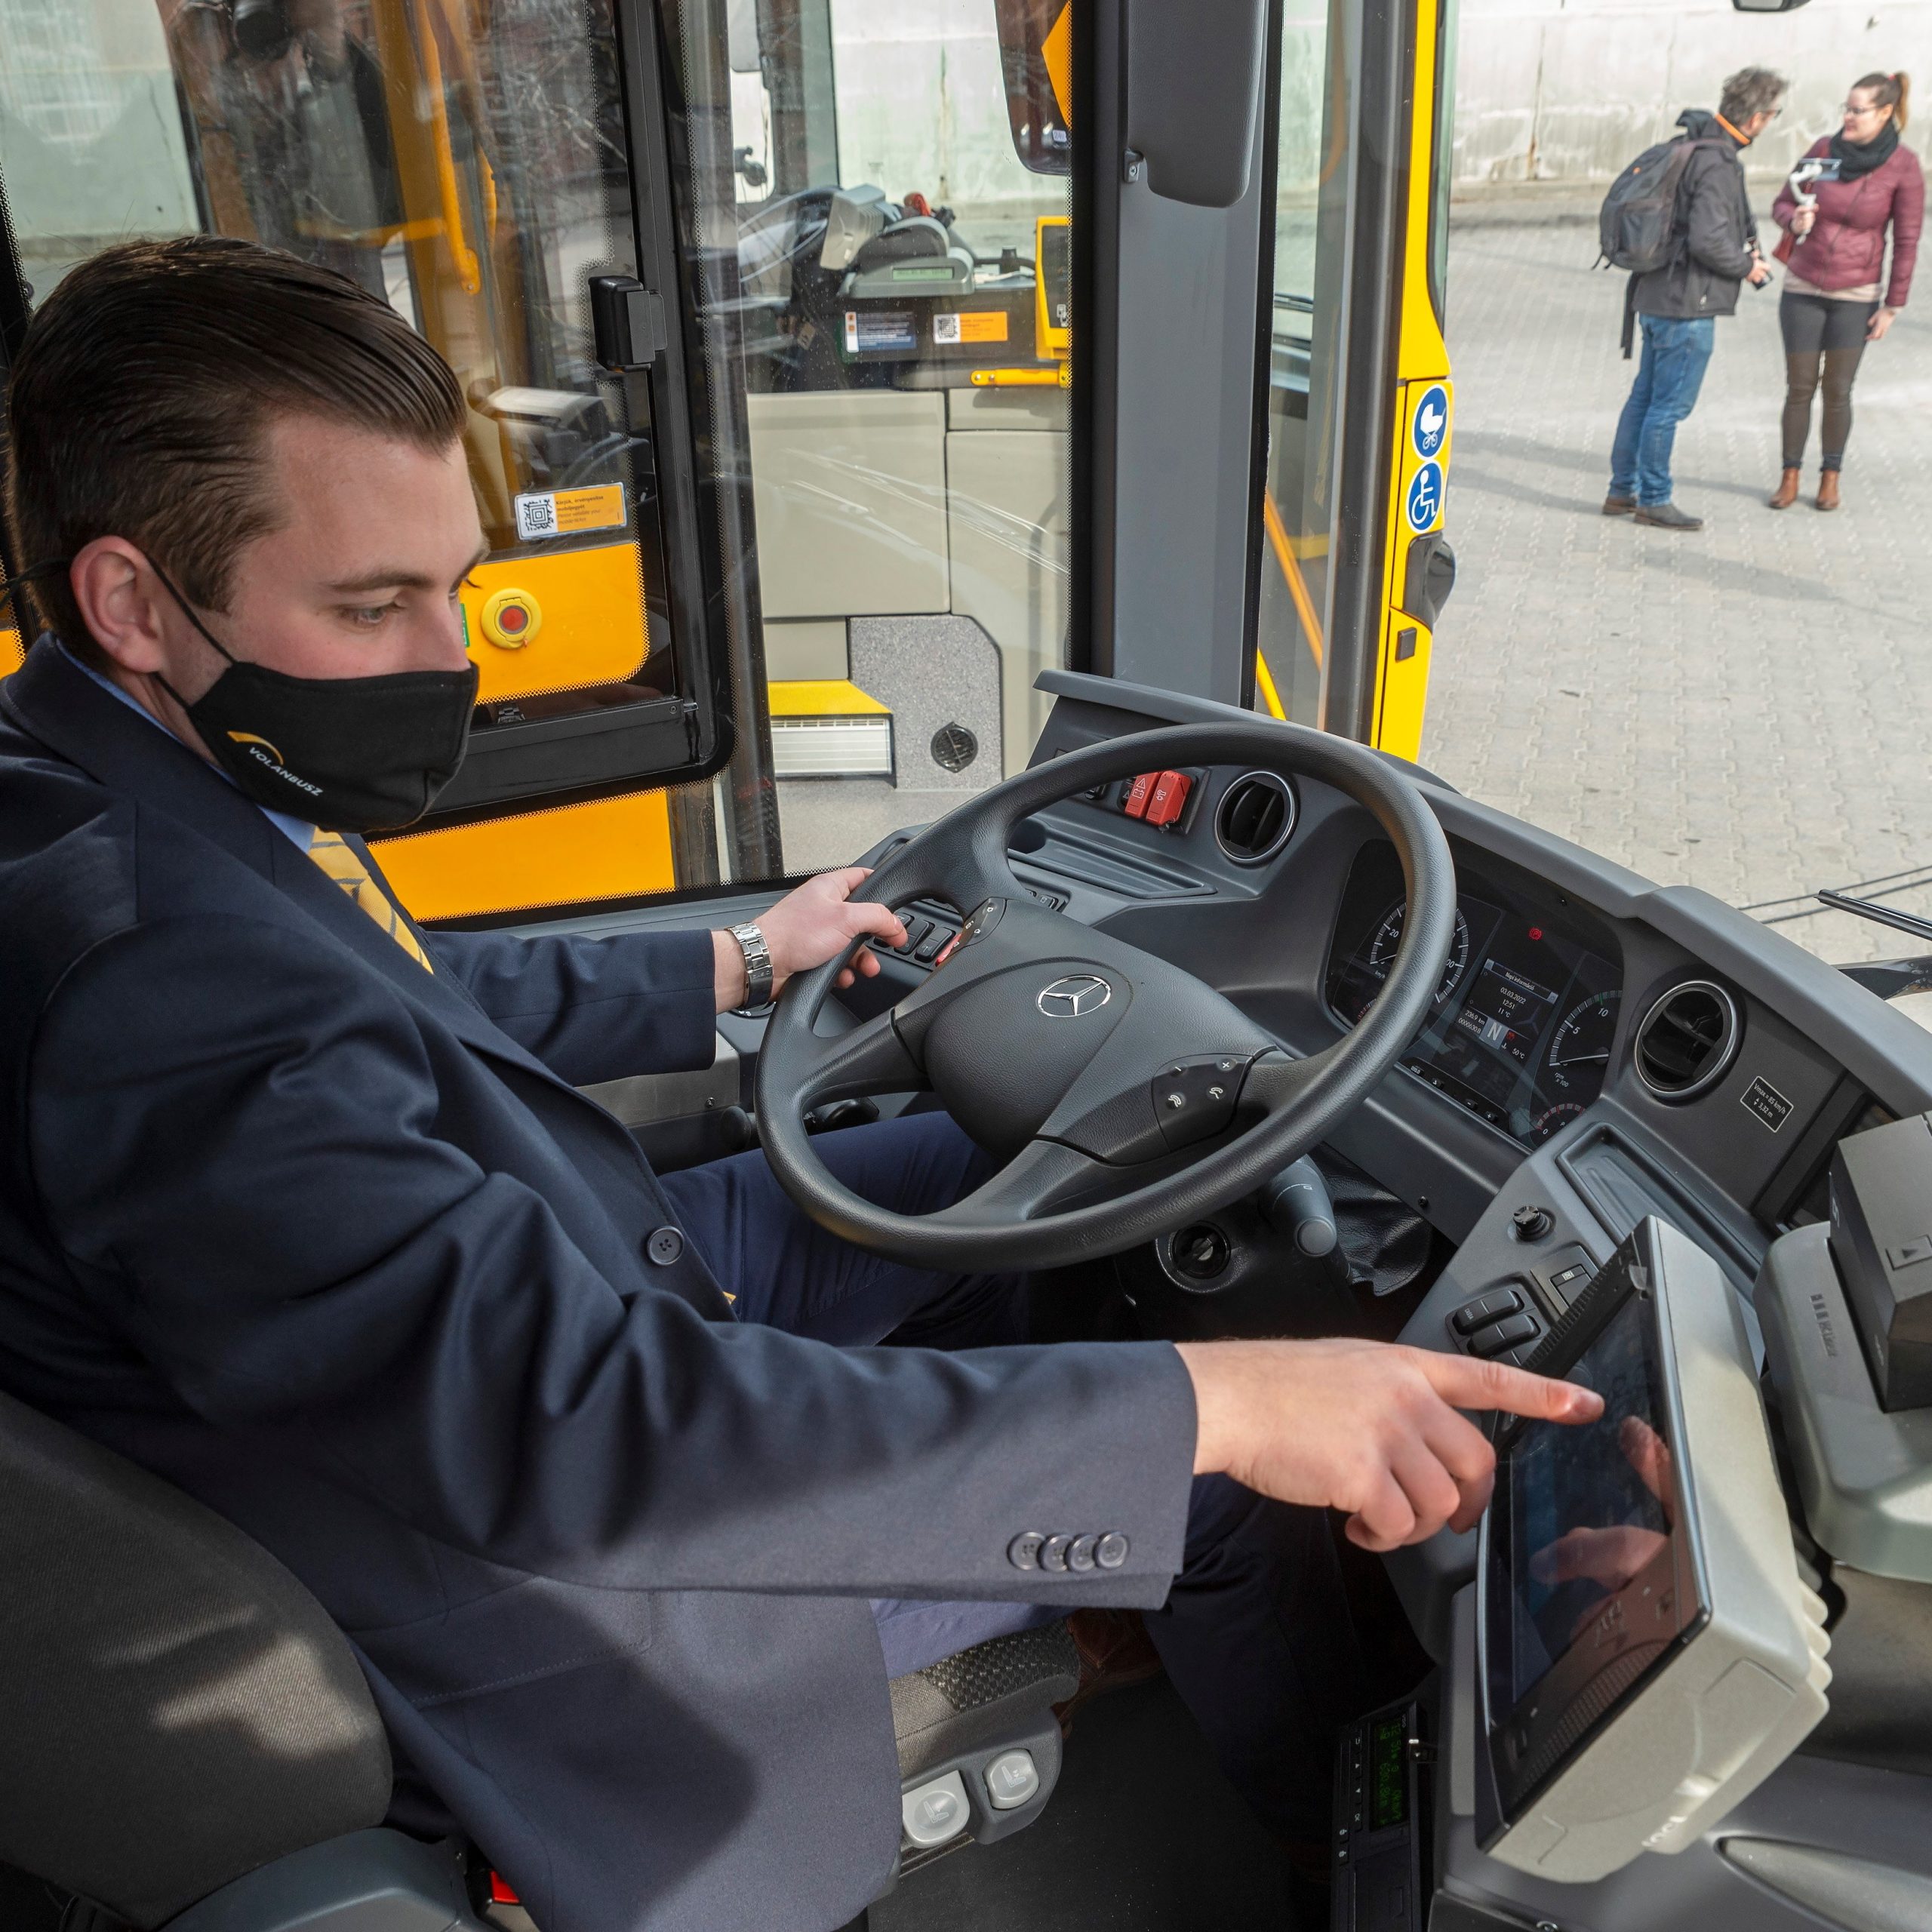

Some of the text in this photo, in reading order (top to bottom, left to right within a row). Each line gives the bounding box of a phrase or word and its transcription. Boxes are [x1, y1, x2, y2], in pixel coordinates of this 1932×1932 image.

[1389, 929, 1399, 938] 20
[1500, 986, 1527, 1005] 03.03.2022
[1598, 1008, 1609, 1017] 10
[1478, 1017, 1485, 1026] km
[1487, 1022, 1503, 1041] N
[1572, 1026, 1580, 1035] 5
[1512, 1048, 1519, 1056] 50
[1555, 1072, 1564, 1080] rpm
[1774, 1100, 1786, 1115] km/h
